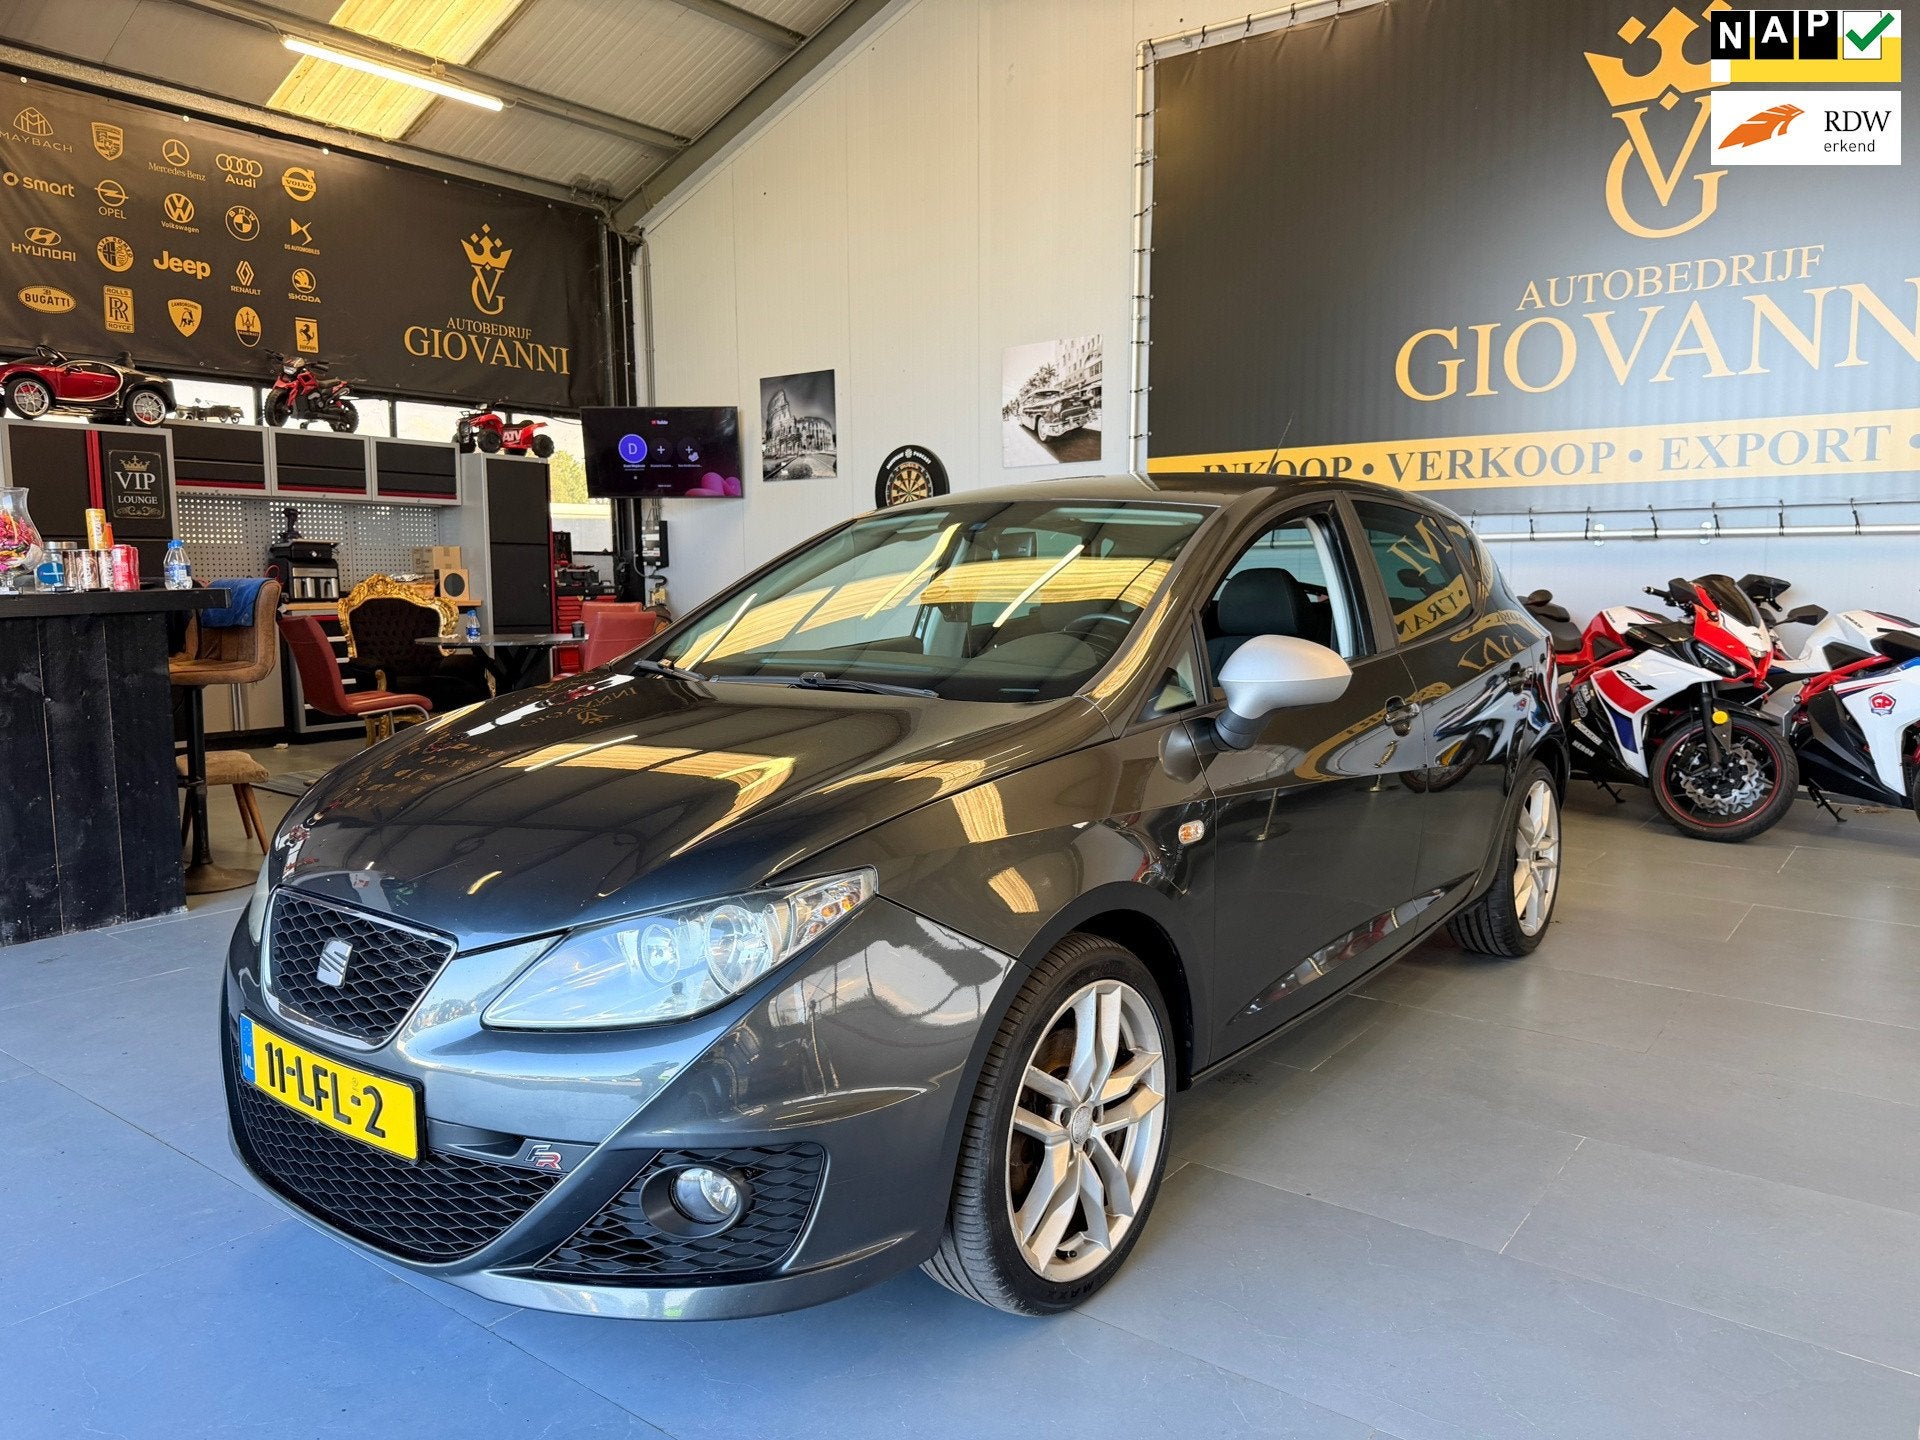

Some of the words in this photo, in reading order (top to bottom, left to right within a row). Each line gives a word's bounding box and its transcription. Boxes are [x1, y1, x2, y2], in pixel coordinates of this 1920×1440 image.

[0, 130, 73, 153] MAYBACH
[148, 162, 207, 182] Mercedes-Benz
[225, 174, 256, 188] Audi
[22, 176, 75, 198] smart
[285, 179, 314, 190] VOLVO
[98, 206, 127, 220] OPEL
[161, 220, 200, 234] Volkswagen
[11, 242, 76, 262] HYUNDAI
[153, 250, 211, 280] Jeep
[1515, 244, 1825, 311] AUTOBEDRIJF
[24, 292, 70, 308] BUGATTI
[106, 287, 129, 296] ROLLS
[230, 285, 261, 296] RENAULT
[108, 322, 131, 331] ROYCE
[446, 317, 532, 340] AUTOBEDRIJF
[404, 325, 570, 375] GIOVANNI
[502, 429, 522, 442] ATV
[628, 443, 638, 455] D
[1385, 439, 1617, 484] VERKOOP
[1657, 424, 1892, 473] EXPORT
[114, 471, 156, 490] VIP
[117, 495, 159, 505] LOUNGE
[244, 1052, 254, 1071] NL
[265, 1041, 386, 1139] 11-LFL-2
[524, 1144, 562, 1170] FR
